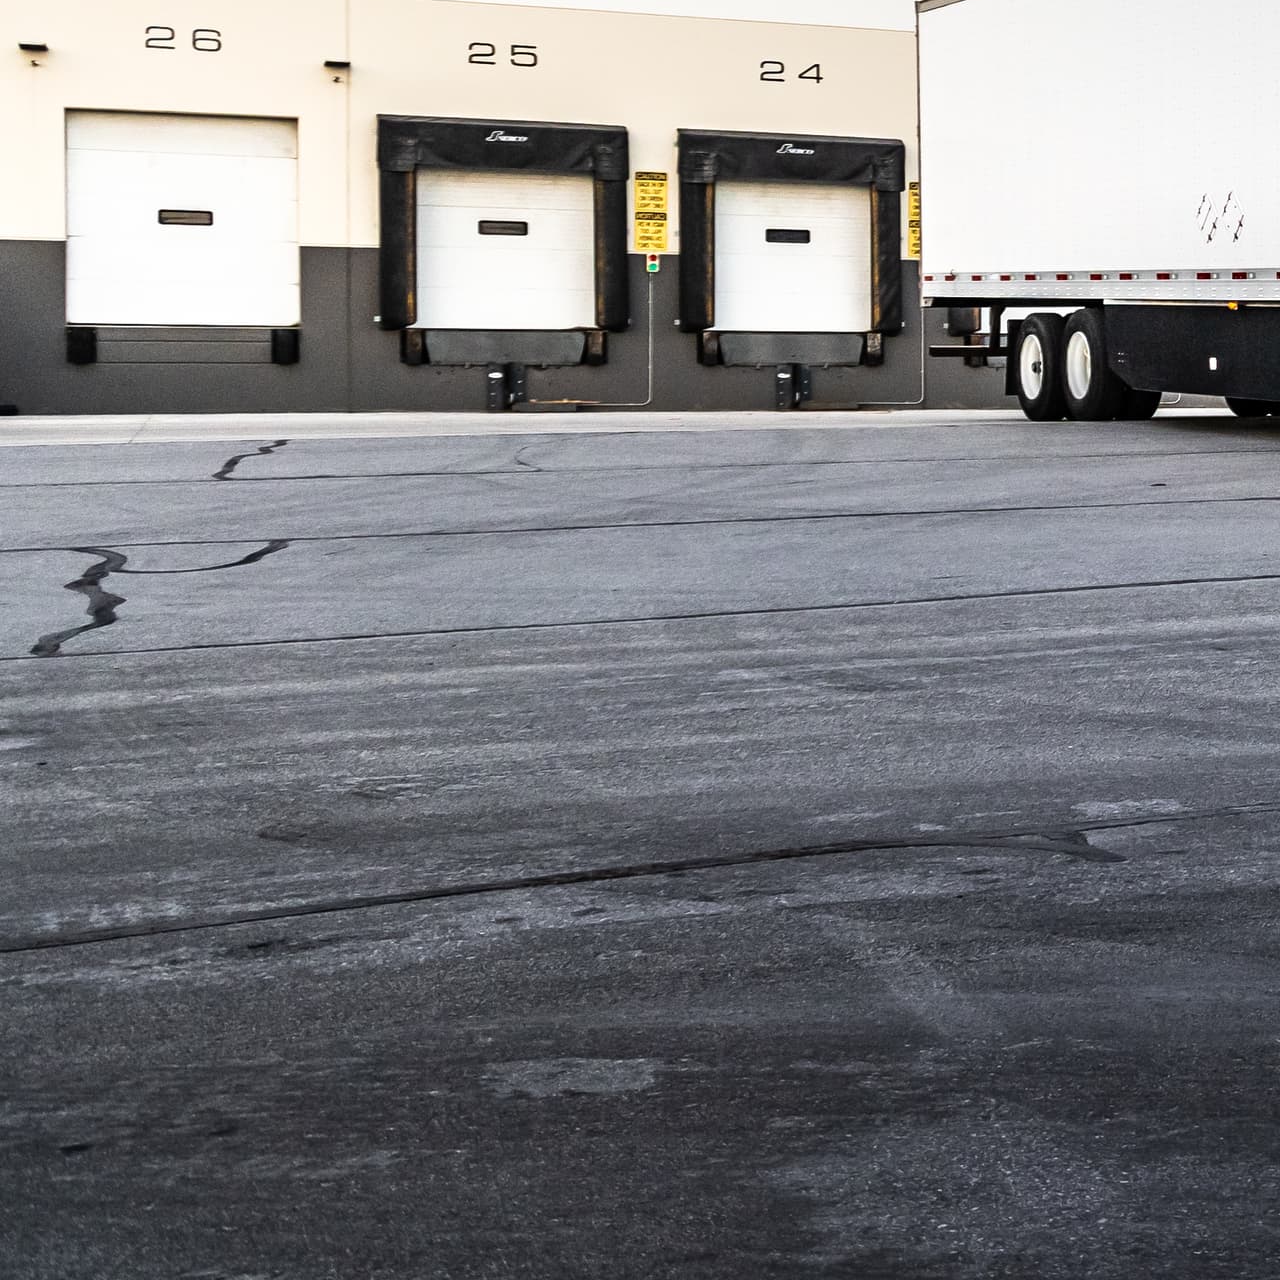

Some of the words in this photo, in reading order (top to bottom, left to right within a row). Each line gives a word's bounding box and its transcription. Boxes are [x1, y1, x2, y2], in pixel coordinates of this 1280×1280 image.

[144, 25, 222, 53] 26
[467, 41, 539, 68] 25
[759, 60, 824, 84] 24
